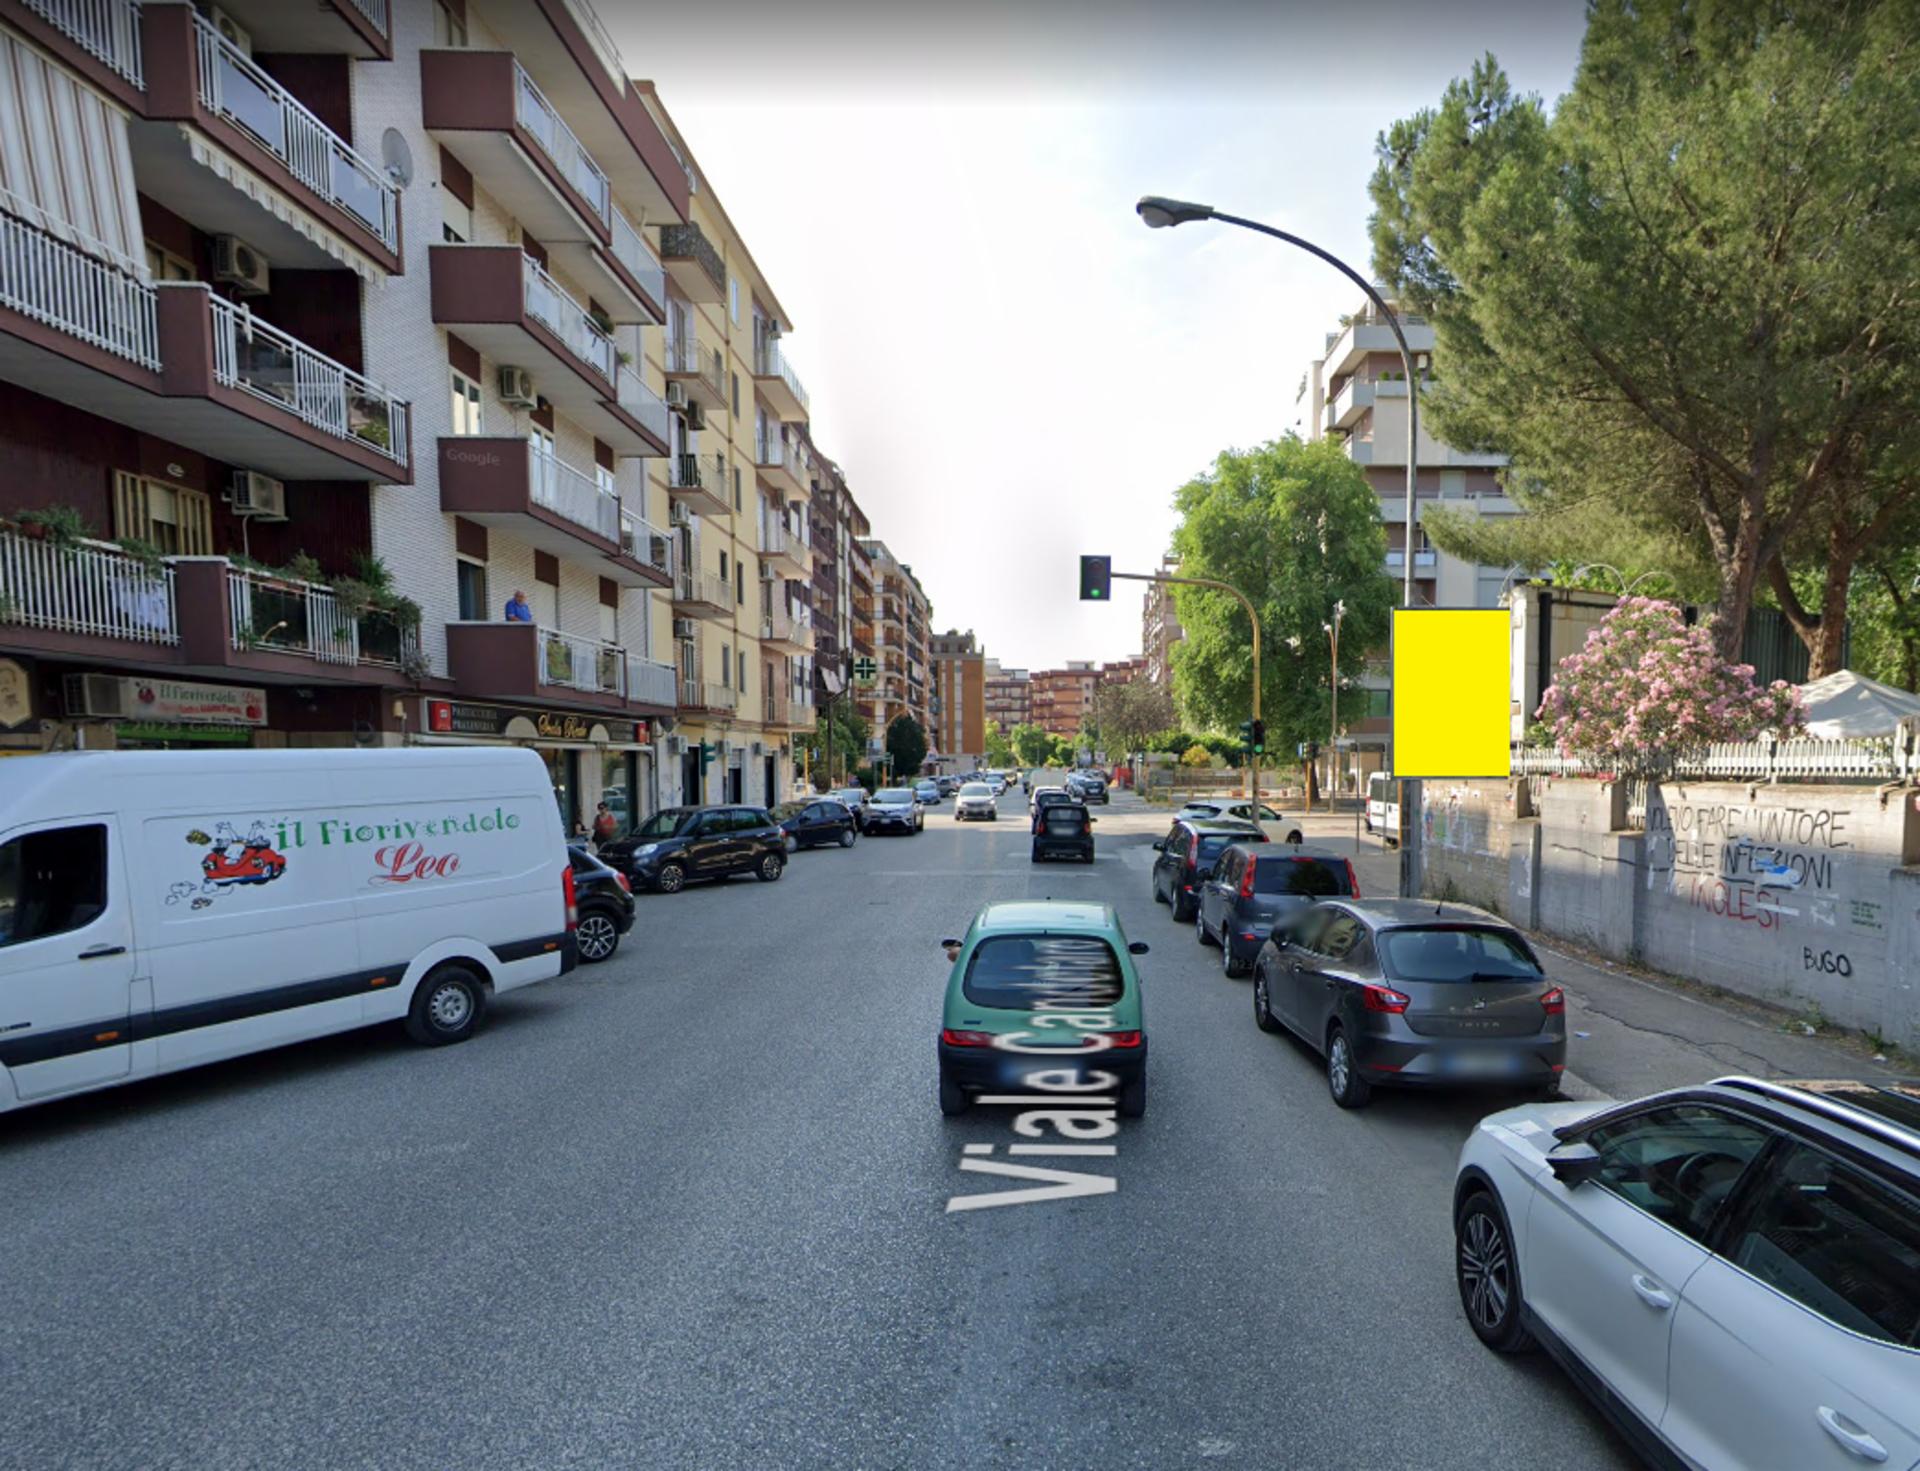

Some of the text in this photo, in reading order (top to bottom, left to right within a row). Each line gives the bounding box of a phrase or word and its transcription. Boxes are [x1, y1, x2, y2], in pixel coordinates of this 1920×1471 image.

[317, 807, 521, 846] Fiorivendolo
[367, 841, 460, 886] Leo
[1803, 946, 1853, 978] BUGO
